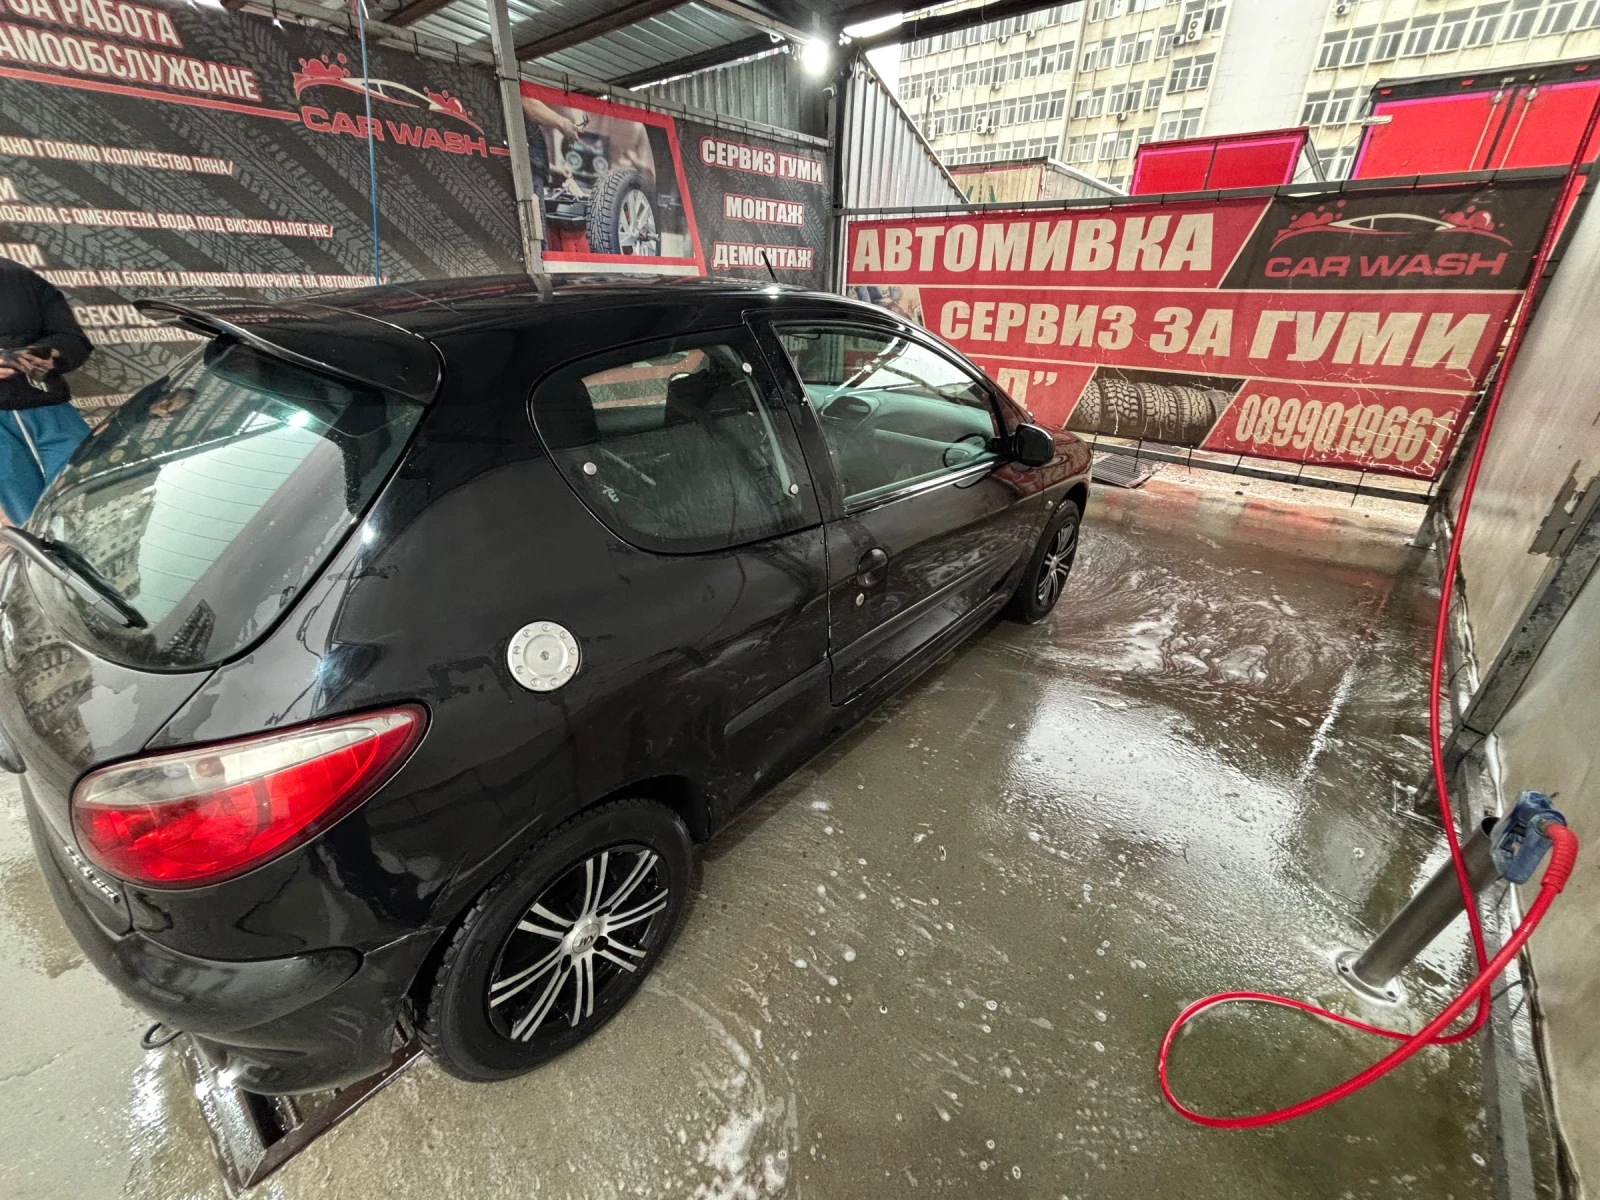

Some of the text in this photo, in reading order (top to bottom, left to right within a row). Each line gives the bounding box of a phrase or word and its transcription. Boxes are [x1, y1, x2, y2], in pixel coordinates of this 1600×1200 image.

[59, 0, 179, 46] РАБОТА
[302, 106, 487, 157] CAR WASH
[35, 139, 101, 162] ГОЛЯМО
[102, 146, 192, 171] КОЛИЧЕСТВО
[192, 156, 234, 176] ПЯНА/
[702, 139, 823, 183] СЕРВИЗ ГУМИ
[72, 207, 157, 228] ОМЕКОТЕНА
[158, 213, 196, 231] ВОДА
[196, 215, 225, 233] ПОД
[225, 218, 273, 235] ВИСОКО
[726, 196, 803, 224] МОНТАЖ
[713, 244, 812, 269] ДЕМОНТАЖ
[852, 213, 1214, 272] АВТОМИВКА
[100, 270, 122, 286] НА
[123, 270, 166, 286] БОЯТА
[167, 271, 178, 286] И
[179, 271, 243, 287] ЛАКОВОТО
[303, 274, 319, 288] НА
[1264, 252, 1508, 278] CAR WASH
[121, 327, 185, 343] ОСМОЗНА
[940, 300, 1491, 370] СЕРВИЗ ЗА ГУМИ
[1235, 393, 1455, 468] 0899019661
